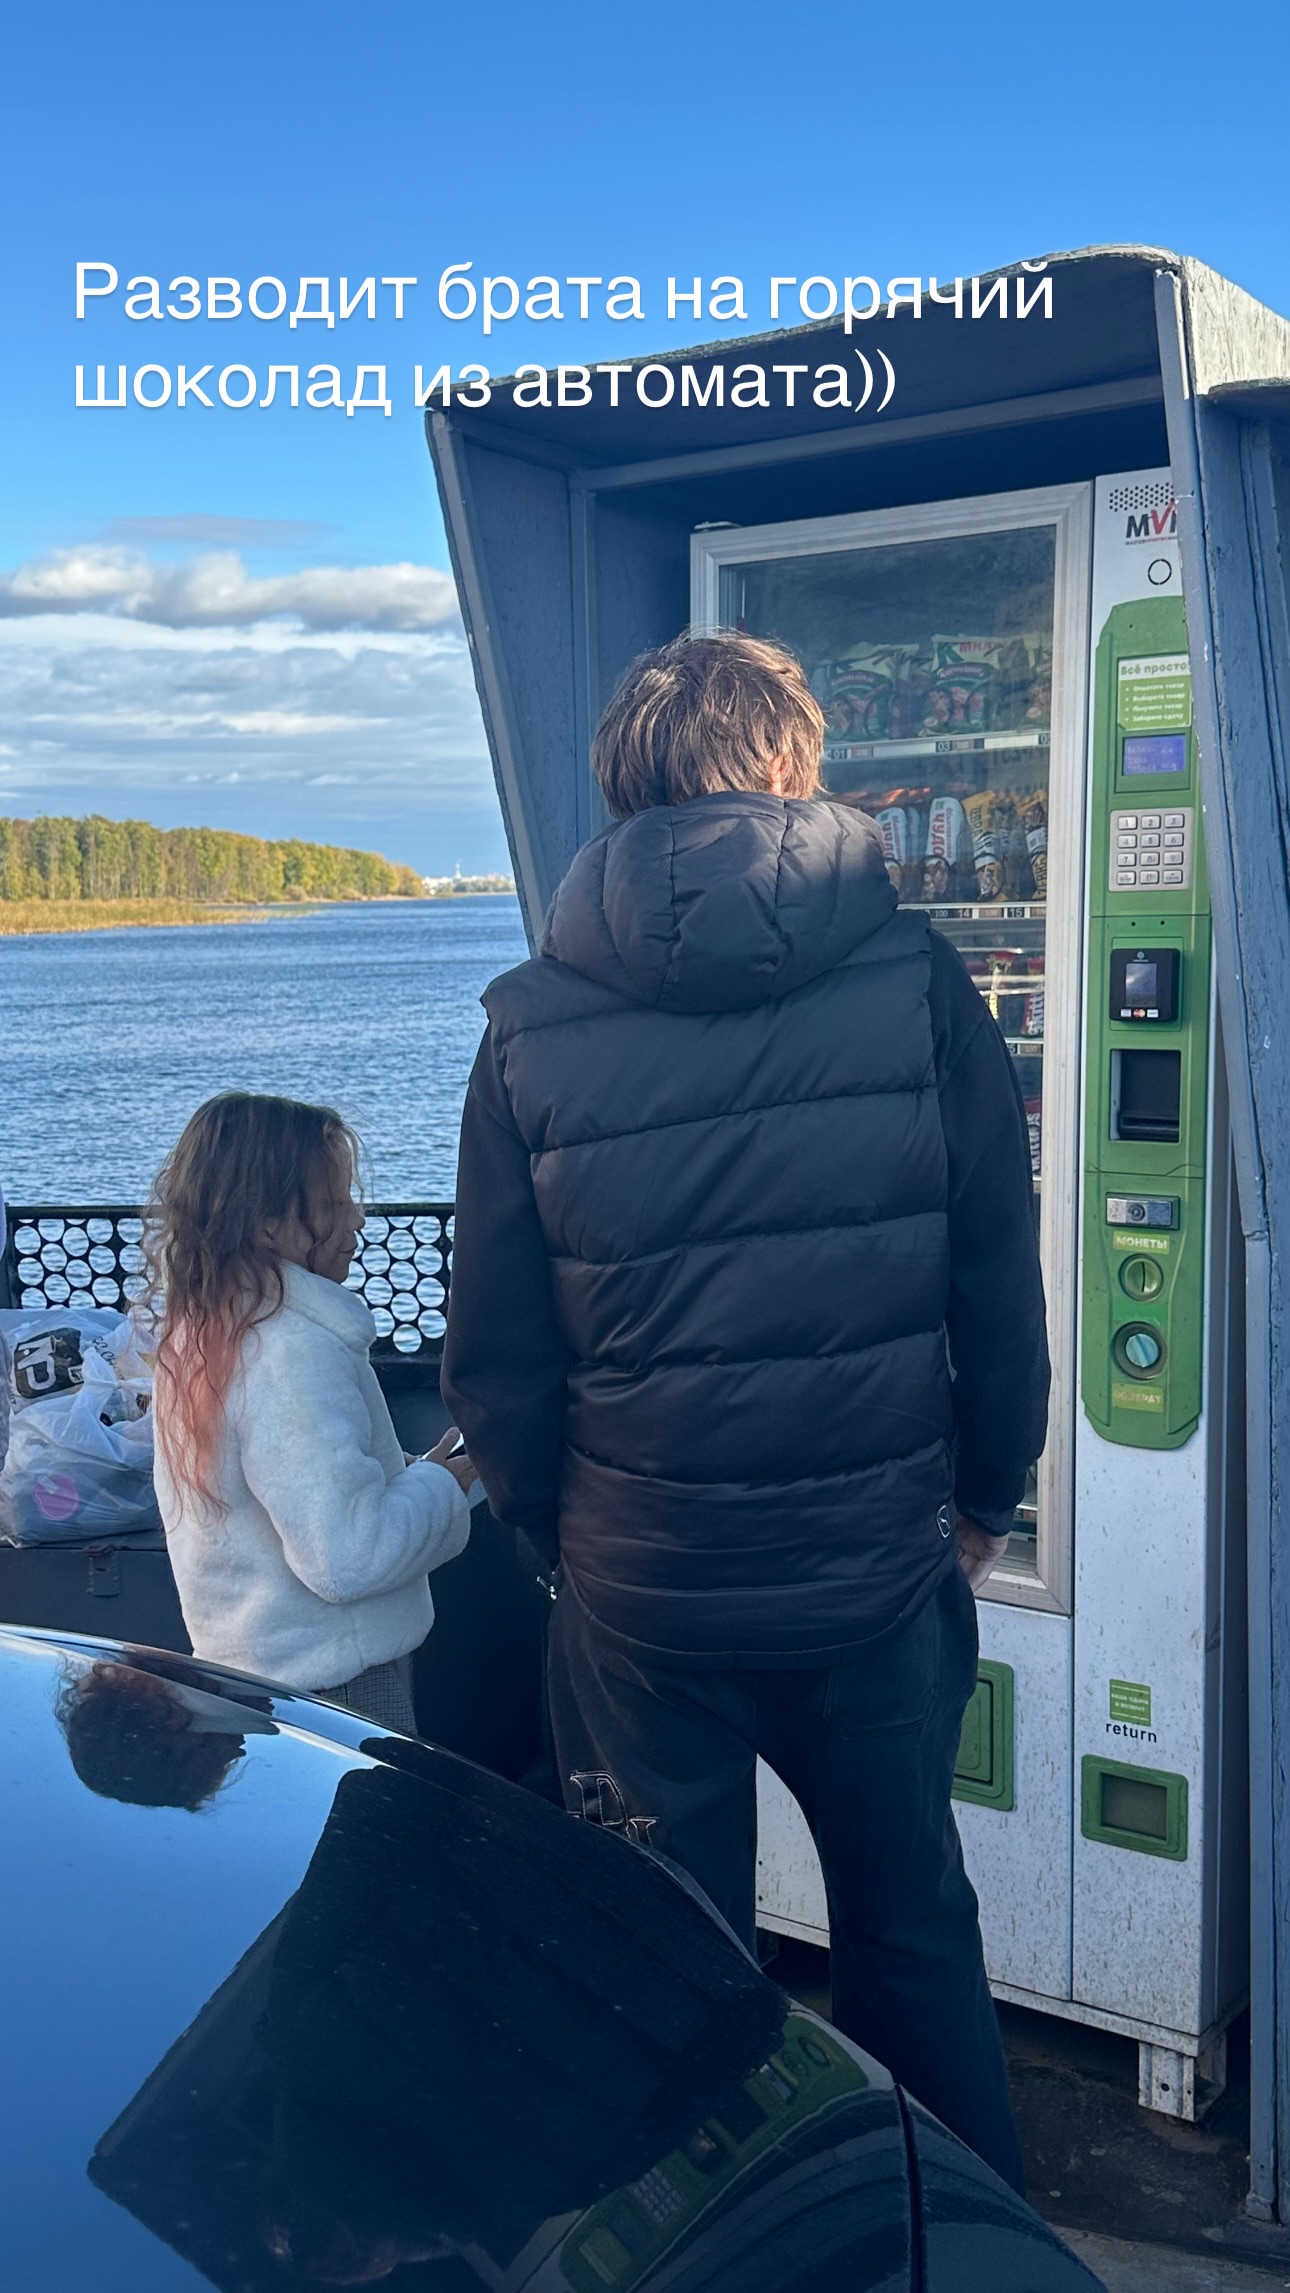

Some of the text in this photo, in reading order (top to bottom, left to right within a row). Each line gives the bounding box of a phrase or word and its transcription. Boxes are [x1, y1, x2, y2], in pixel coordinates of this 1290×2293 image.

[1120, 663, 1141, 676] Всё
[1009, 908, 1023, 918] 15
[1115, 1236, 1168, 1249] МОНЕТЫ
[1105, 1722, 1157, 1744] return
